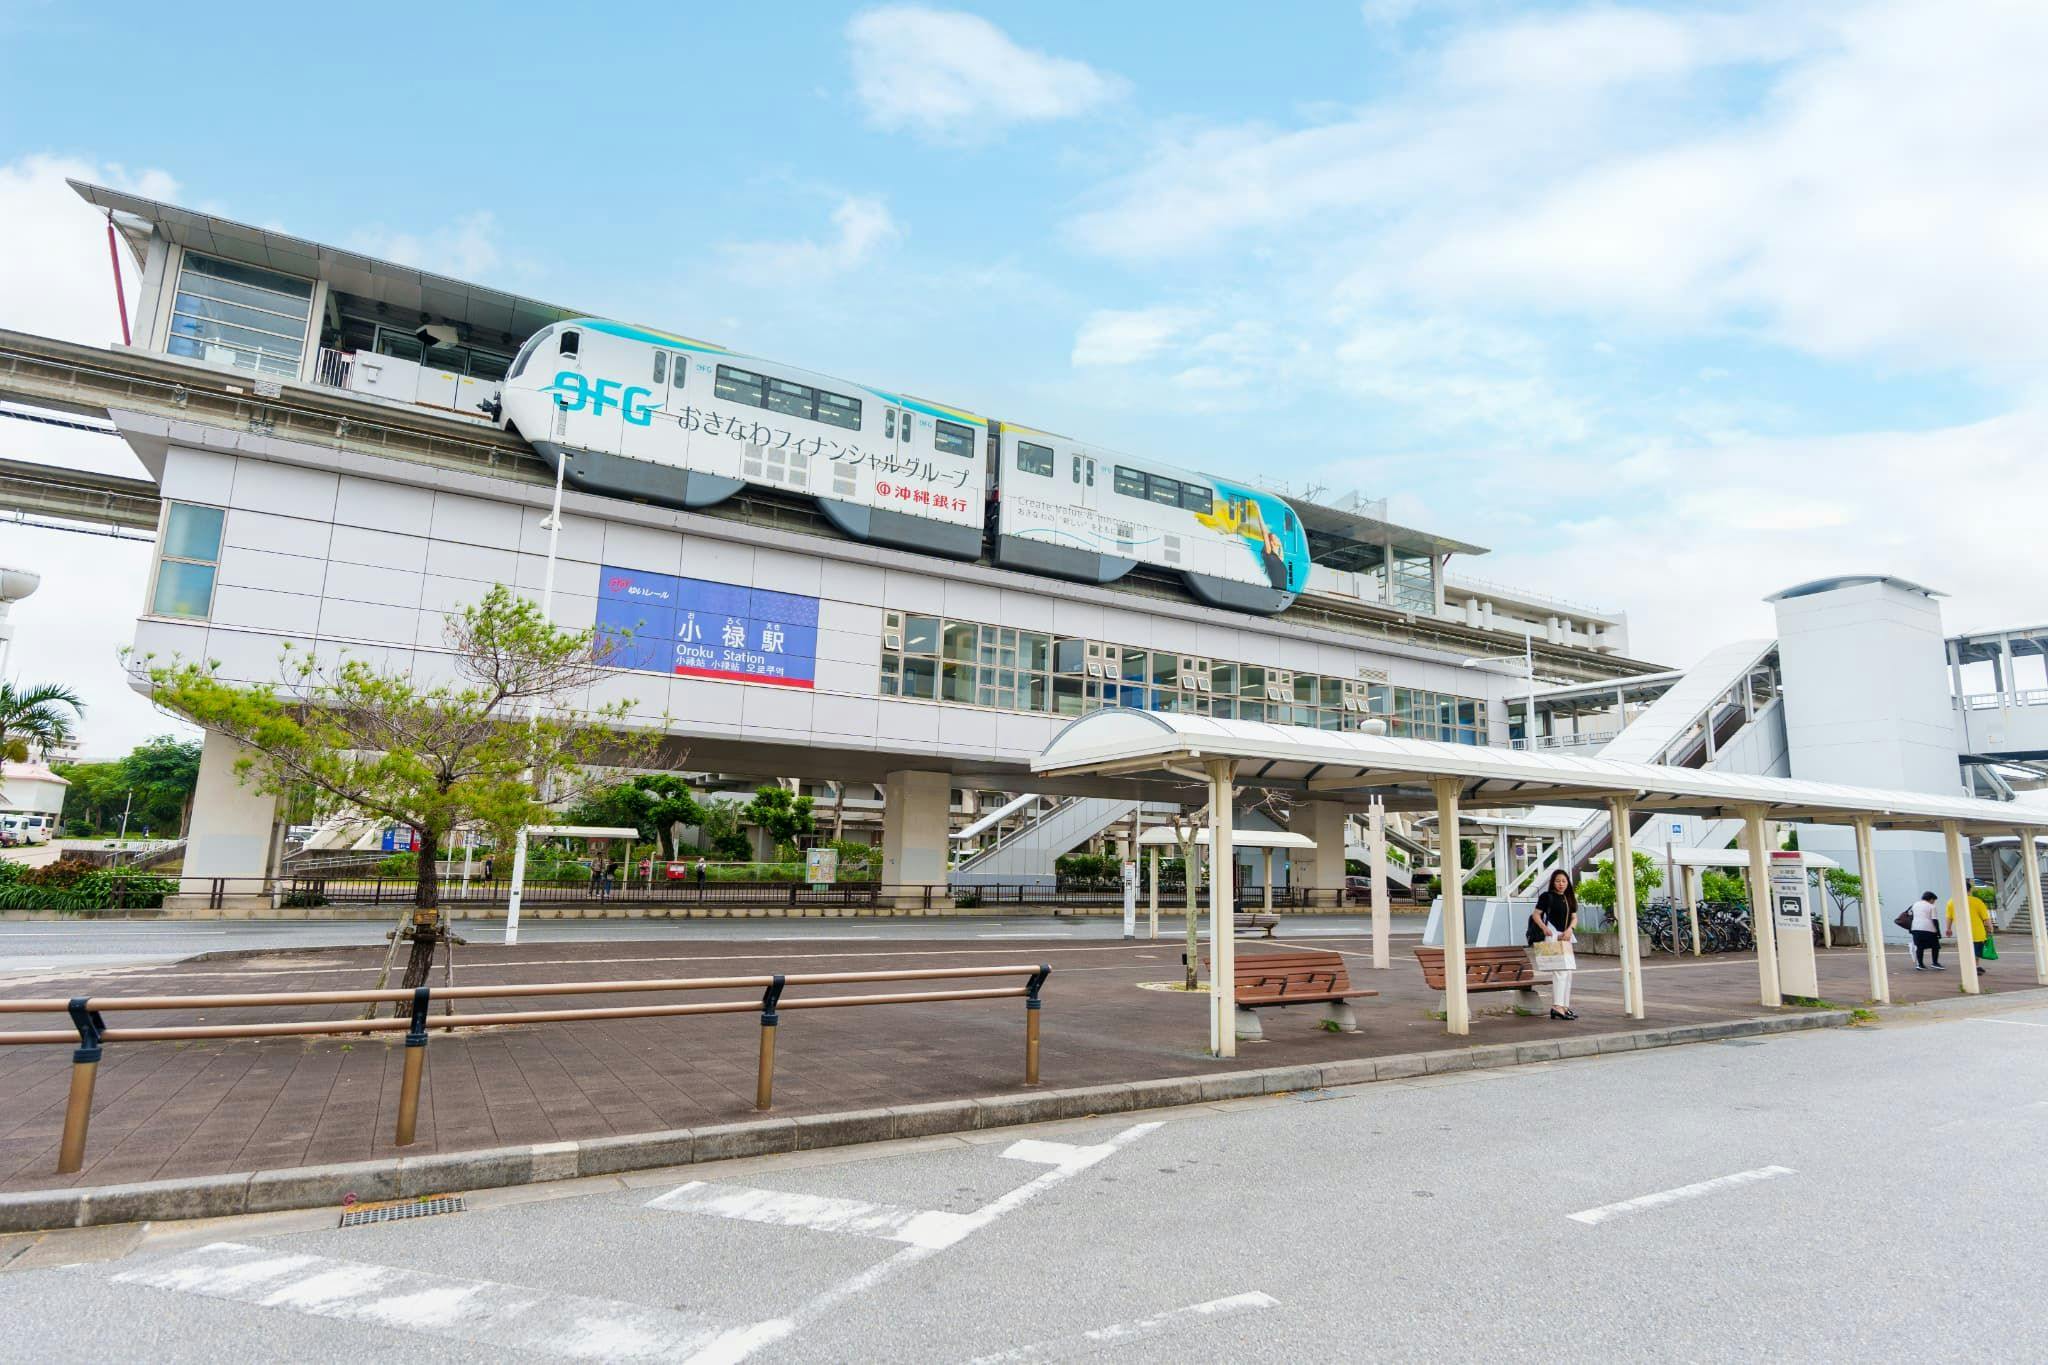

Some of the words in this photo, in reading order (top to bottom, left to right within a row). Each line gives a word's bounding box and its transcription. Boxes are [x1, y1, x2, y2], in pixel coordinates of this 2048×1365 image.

[548, 370, 656, 428] OFG
[677, 405, 970, 488] おきなわフィナンシャルグループ
[895, 484, 967, 512] 沖縄銀行
[1018, 497, 1052, 511] Create
[628, 586, 670, 599] ゆいレール
[678, 619, 784, 653] 小禄駅
[676, 644, 714, 659] Oroku
[723, 650, 765, 665] Station
